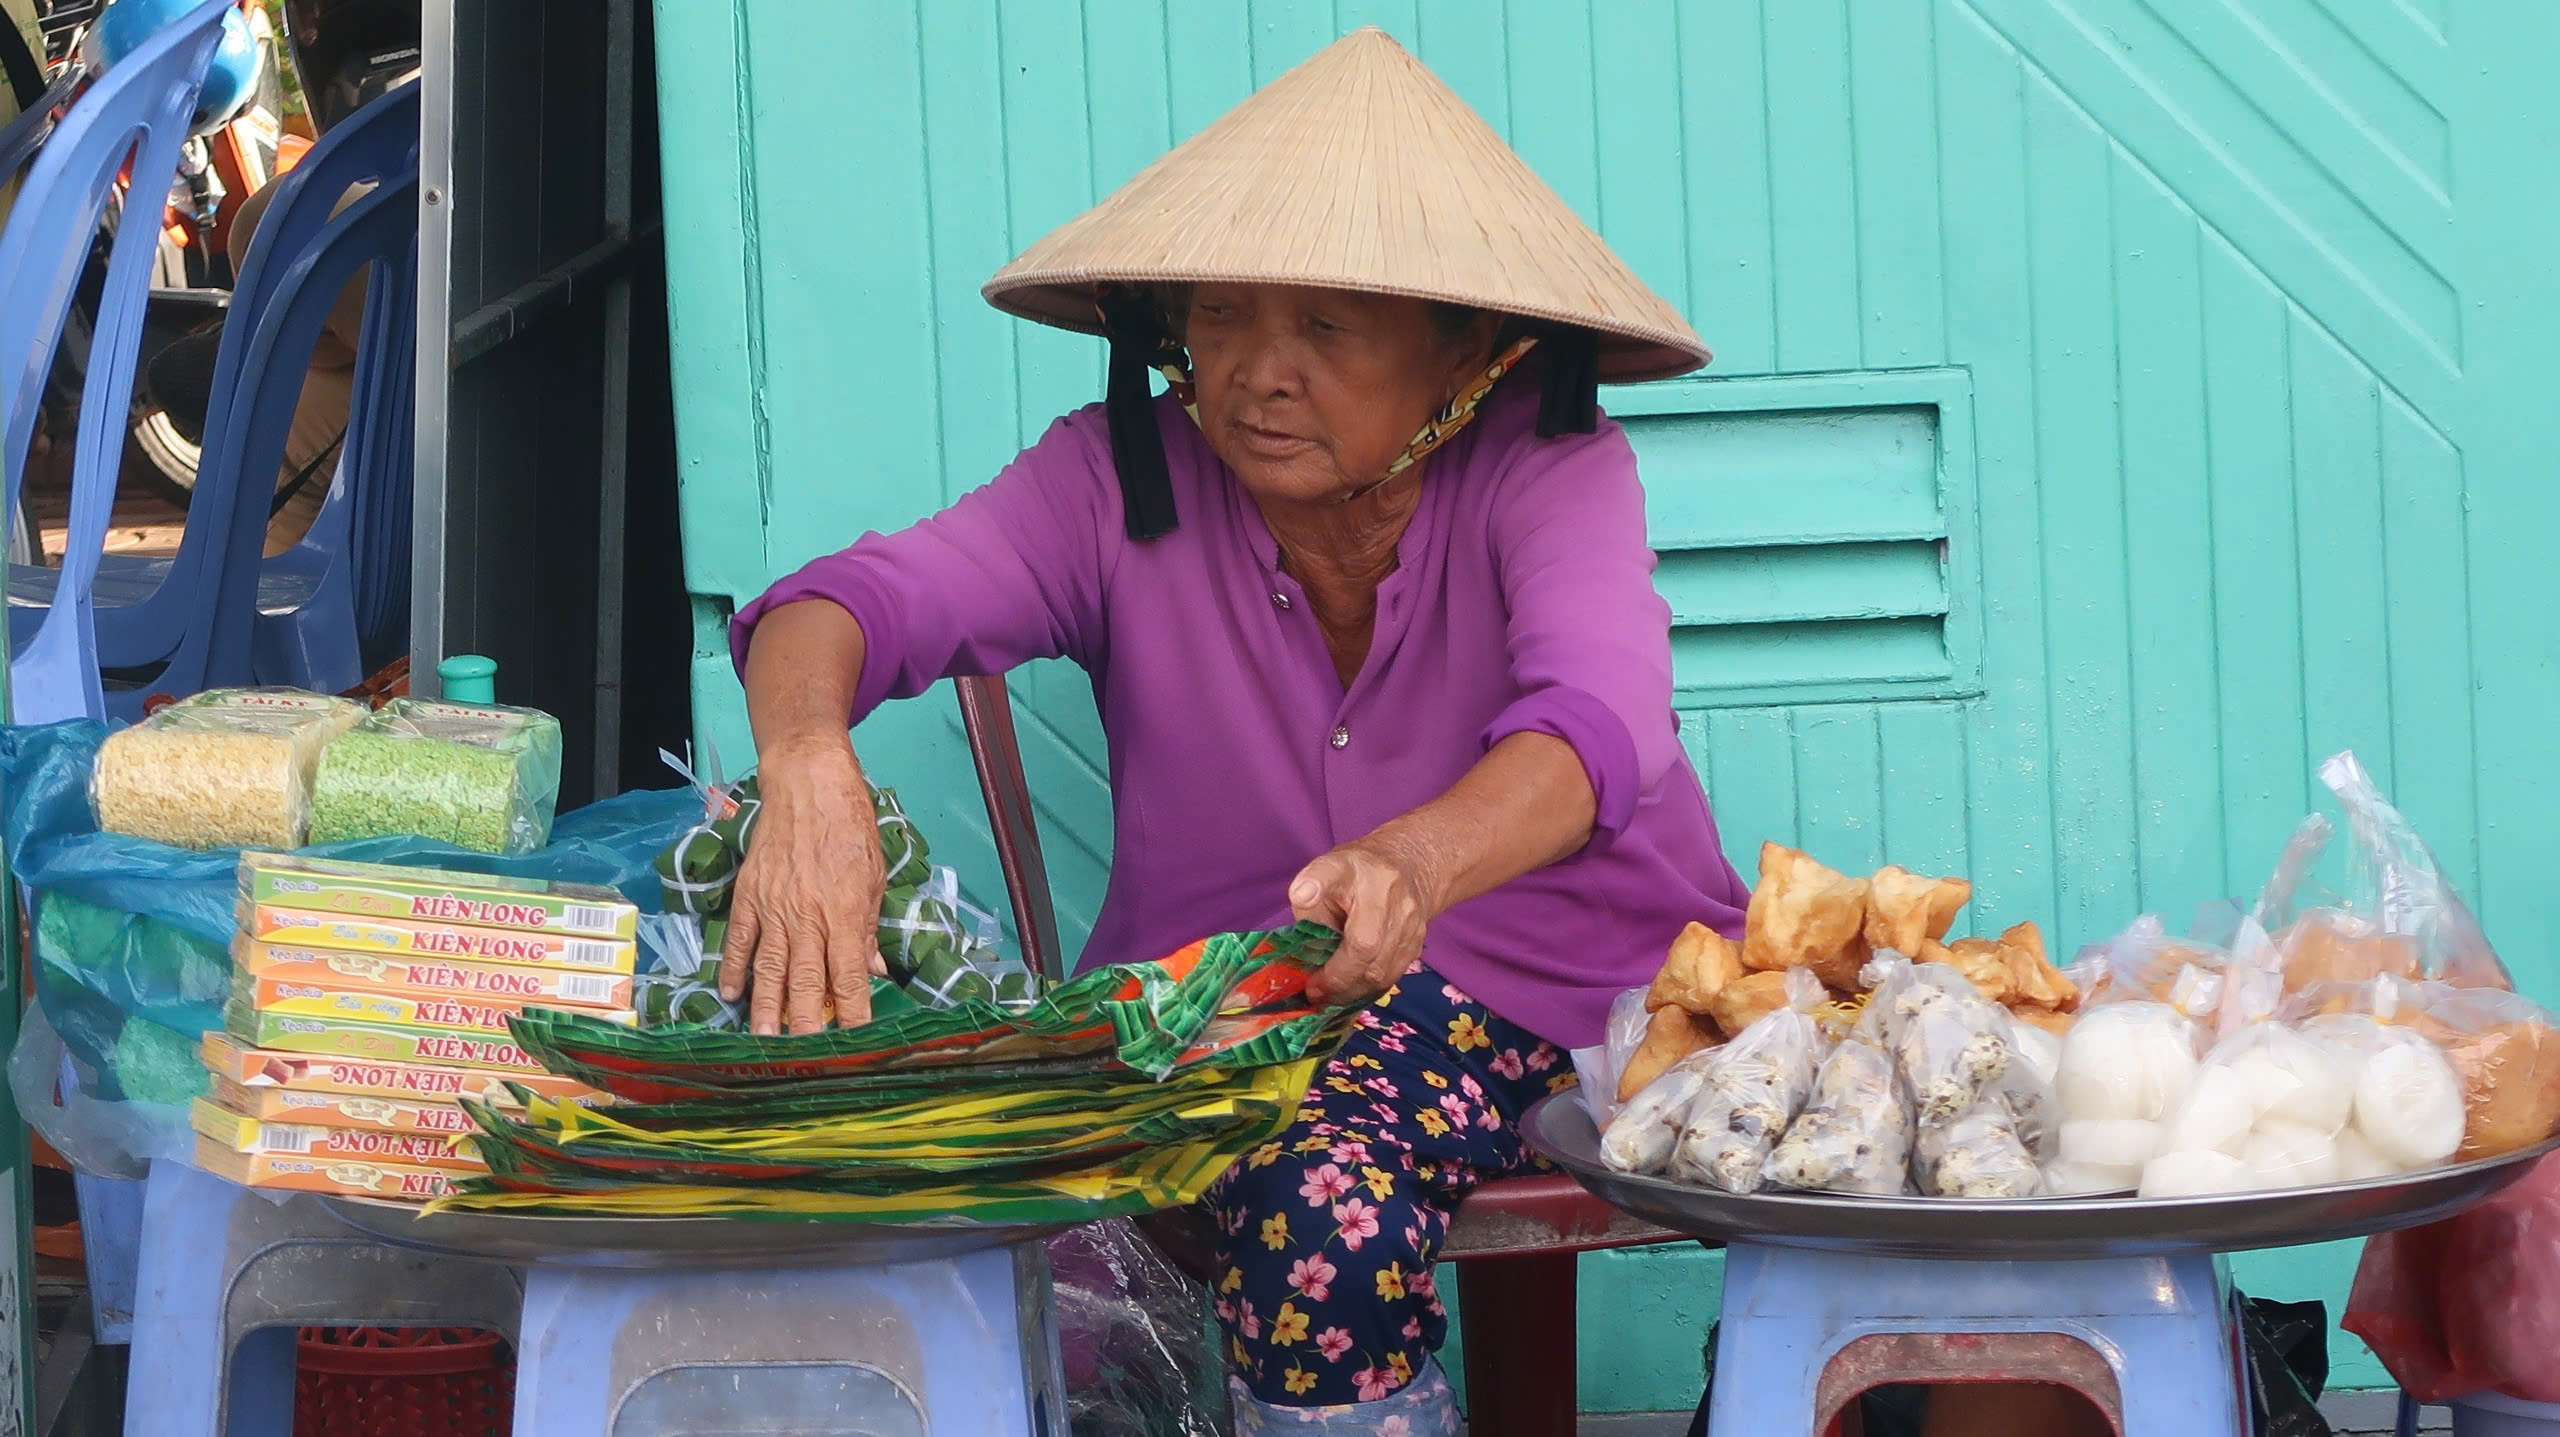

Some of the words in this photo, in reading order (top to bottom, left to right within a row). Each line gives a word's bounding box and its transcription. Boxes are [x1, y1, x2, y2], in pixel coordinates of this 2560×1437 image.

[412, 894, 474, 919] KIÊN
[480, 903, 546, 926] LONG
[412, 929, 474, 953] KIÊN
[480, 938, 546, 961] LONG
[407, 963, 469, 988] KIÊN
[475, 973, 541, 995] LONG
[415, 1000, 477, 1025] KIÊN
[416, 1035, 478, 1059] KIÊN
[333, 1065, 398, 1088] LONG
[402, 1070, 464, 1096] KIÊN
[329, 1130, 394, 1154] LONG
